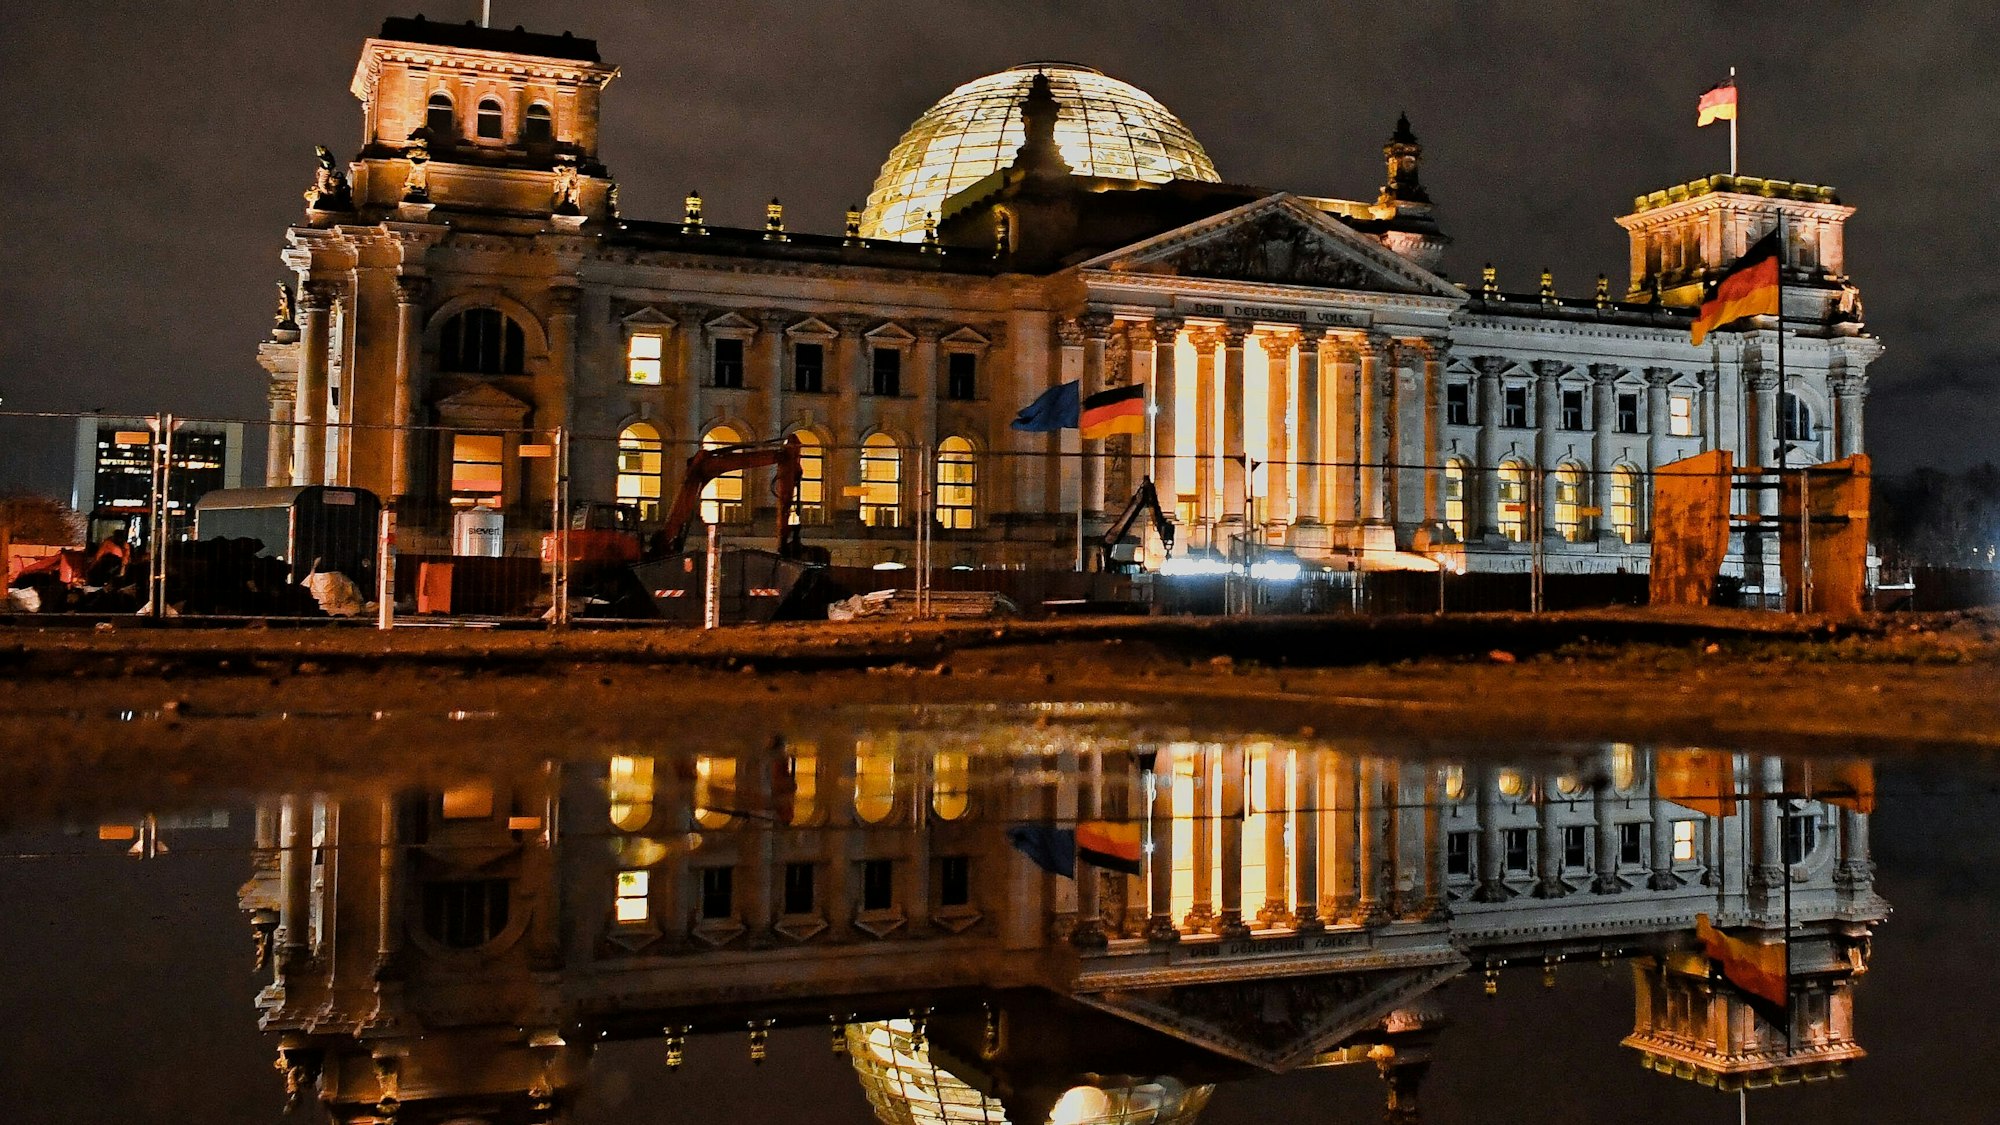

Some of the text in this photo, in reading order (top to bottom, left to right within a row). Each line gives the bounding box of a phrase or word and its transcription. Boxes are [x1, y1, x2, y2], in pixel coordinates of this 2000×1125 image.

[1195, 303, 1353, 323] DEM DEUTSCHEN VOLKE
